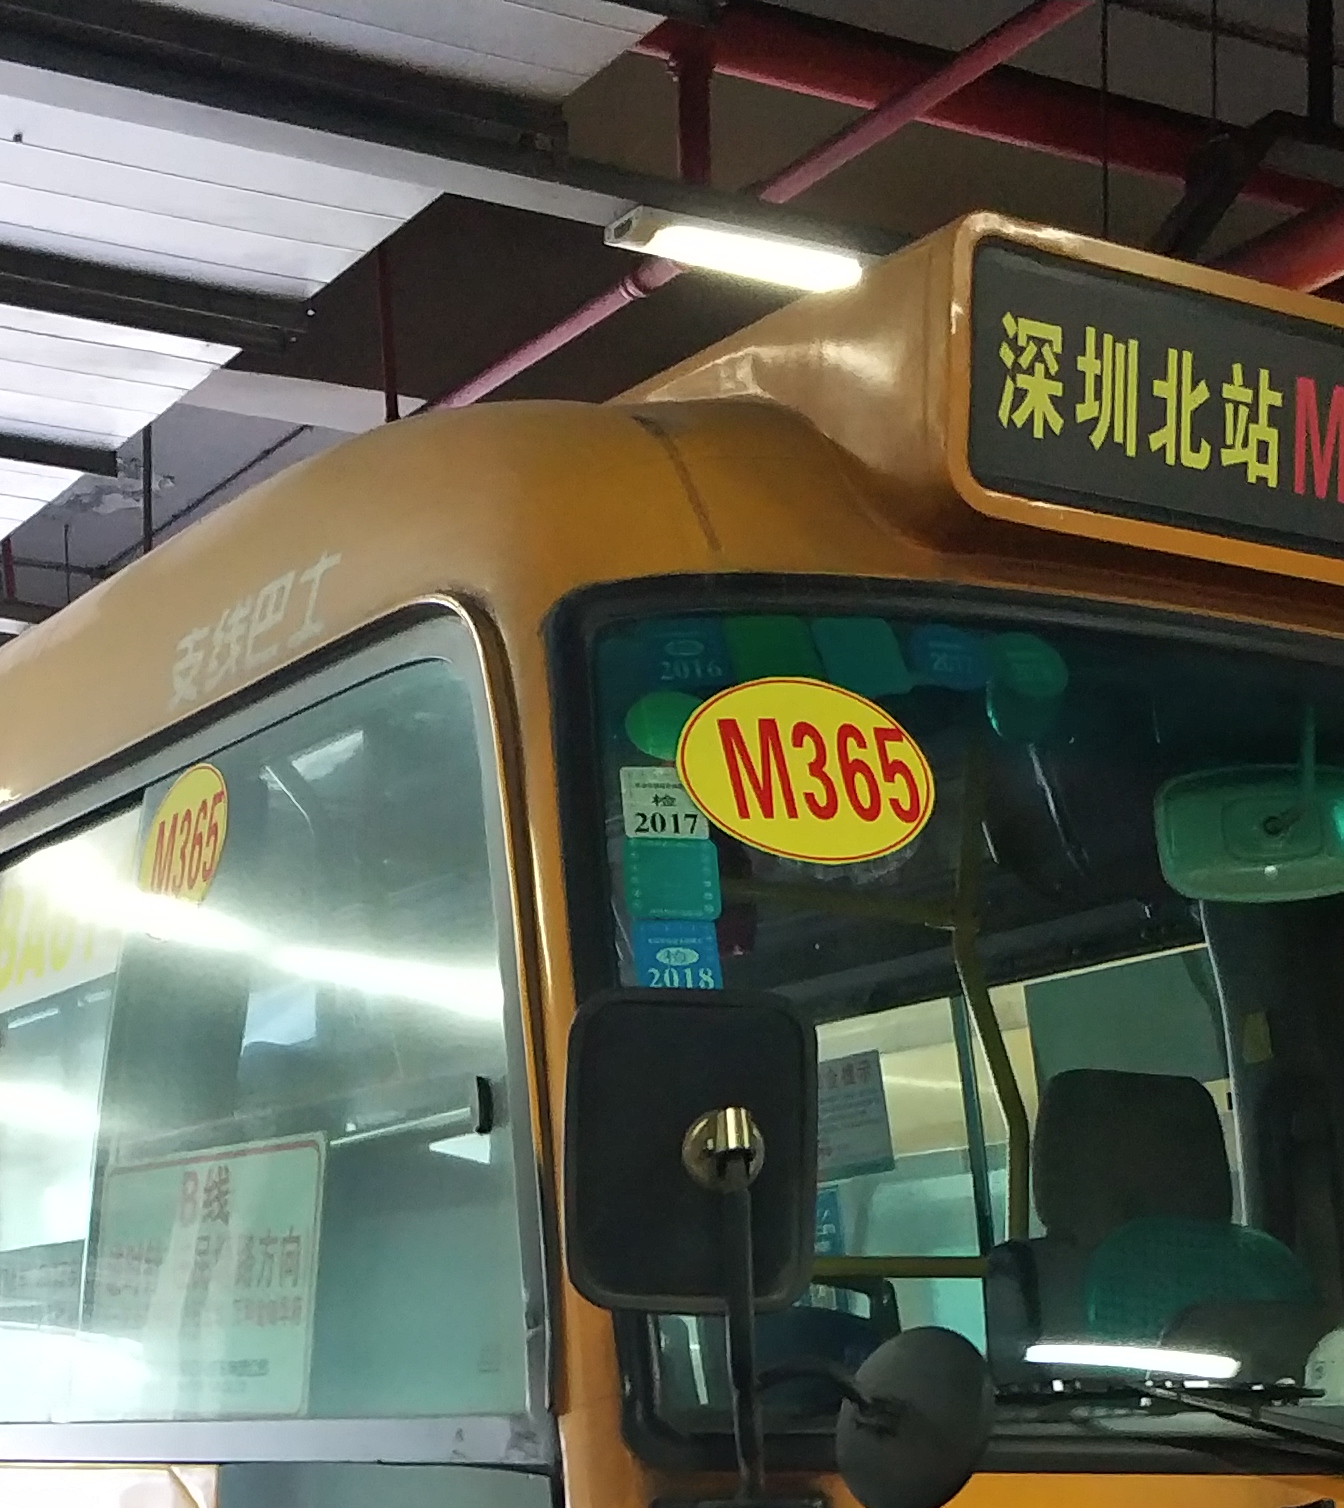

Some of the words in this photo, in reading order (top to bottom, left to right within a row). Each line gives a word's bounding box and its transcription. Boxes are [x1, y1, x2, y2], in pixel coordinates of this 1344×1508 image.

[997, 310, 1283, 489] 深圳北站
[635, 811, 698, 835] 2017
[716, 717, 920, 824] M365
[150, 789, 225, 898] M365
[647, 967, 715, 989] 2018
